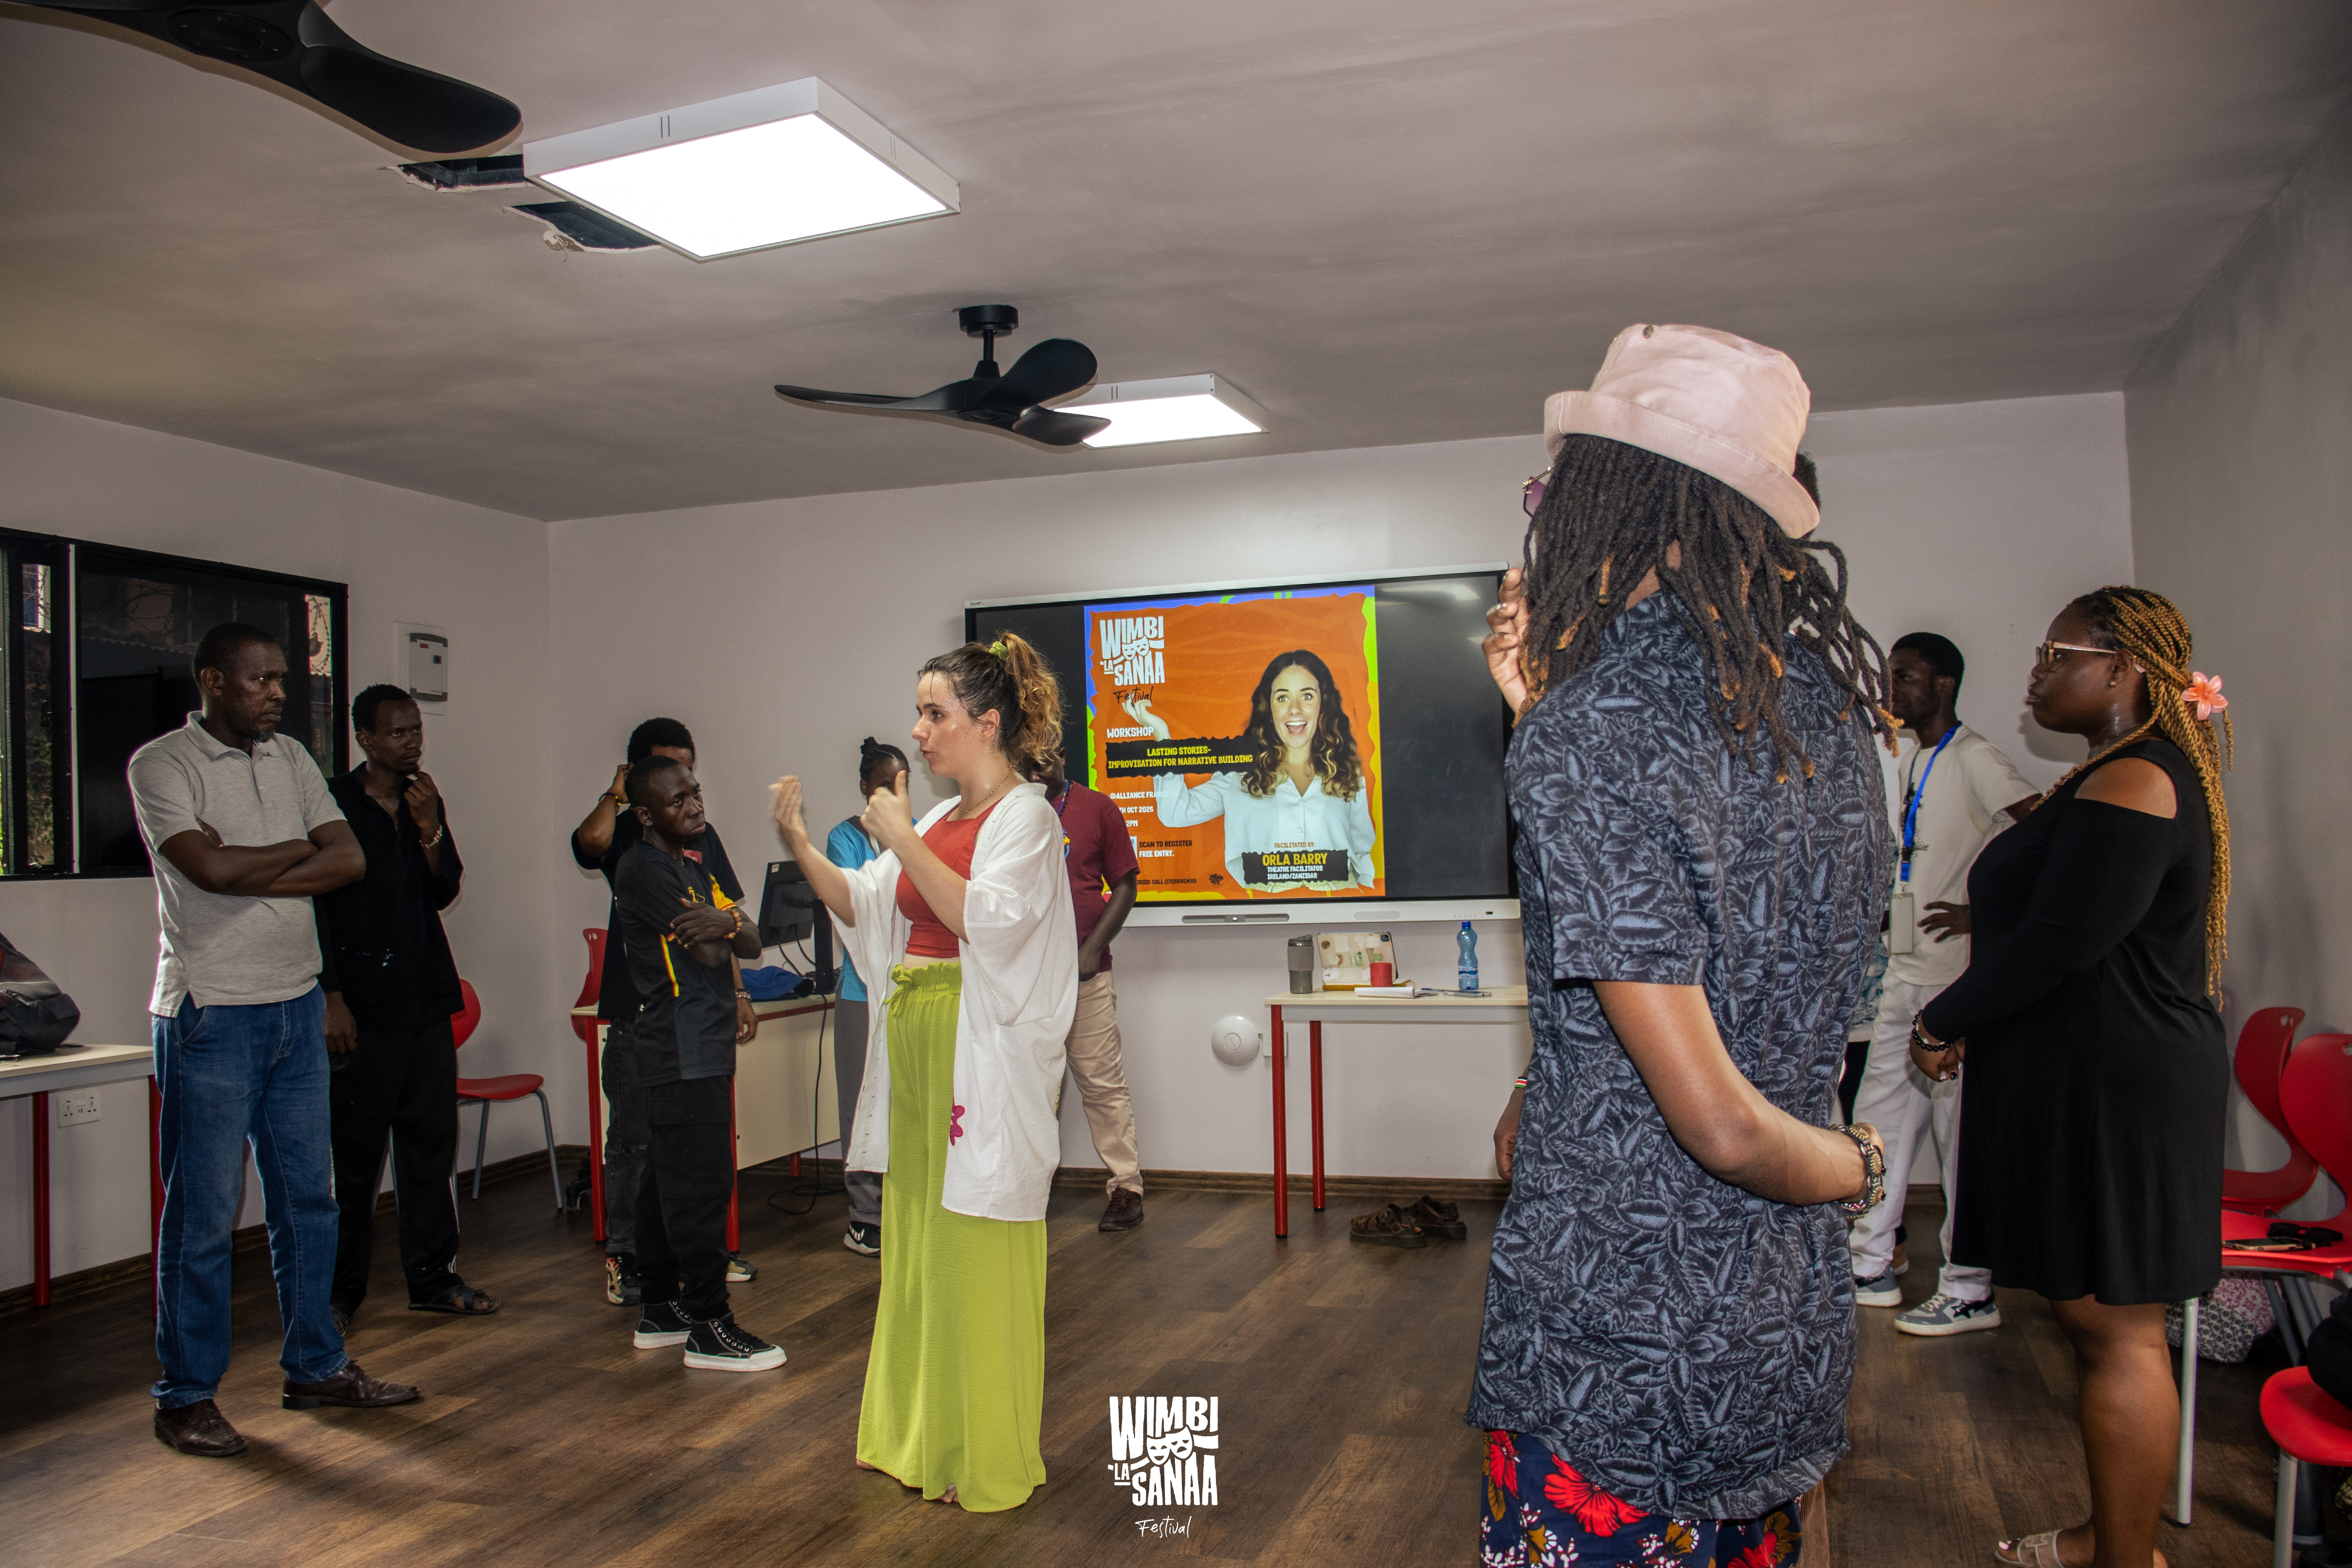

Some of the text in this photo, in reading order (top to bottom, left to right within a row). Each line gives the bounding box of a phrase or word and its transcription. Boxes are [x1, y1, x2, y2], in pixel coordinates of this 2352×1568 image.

[1100, 616, 1164, 659] WIMBI
[1104, 660, 1114, 671] LA
[1114, 651, 1165, 686] SANAA
[1113, 686, 1154, 704] Festival
[1107, 726, 1154, 738] WORKSHOP
[1147, 746, 1211, 757] LASTING STORIES-
[1108, 759, 1162, 769] IMPROVISATION
[1178, 756, 1217, 766] NARRATIVE
[1218, 754, 1253, 764] BUILDING
[1262, 853, 1328, 866] ORLA BARRY
